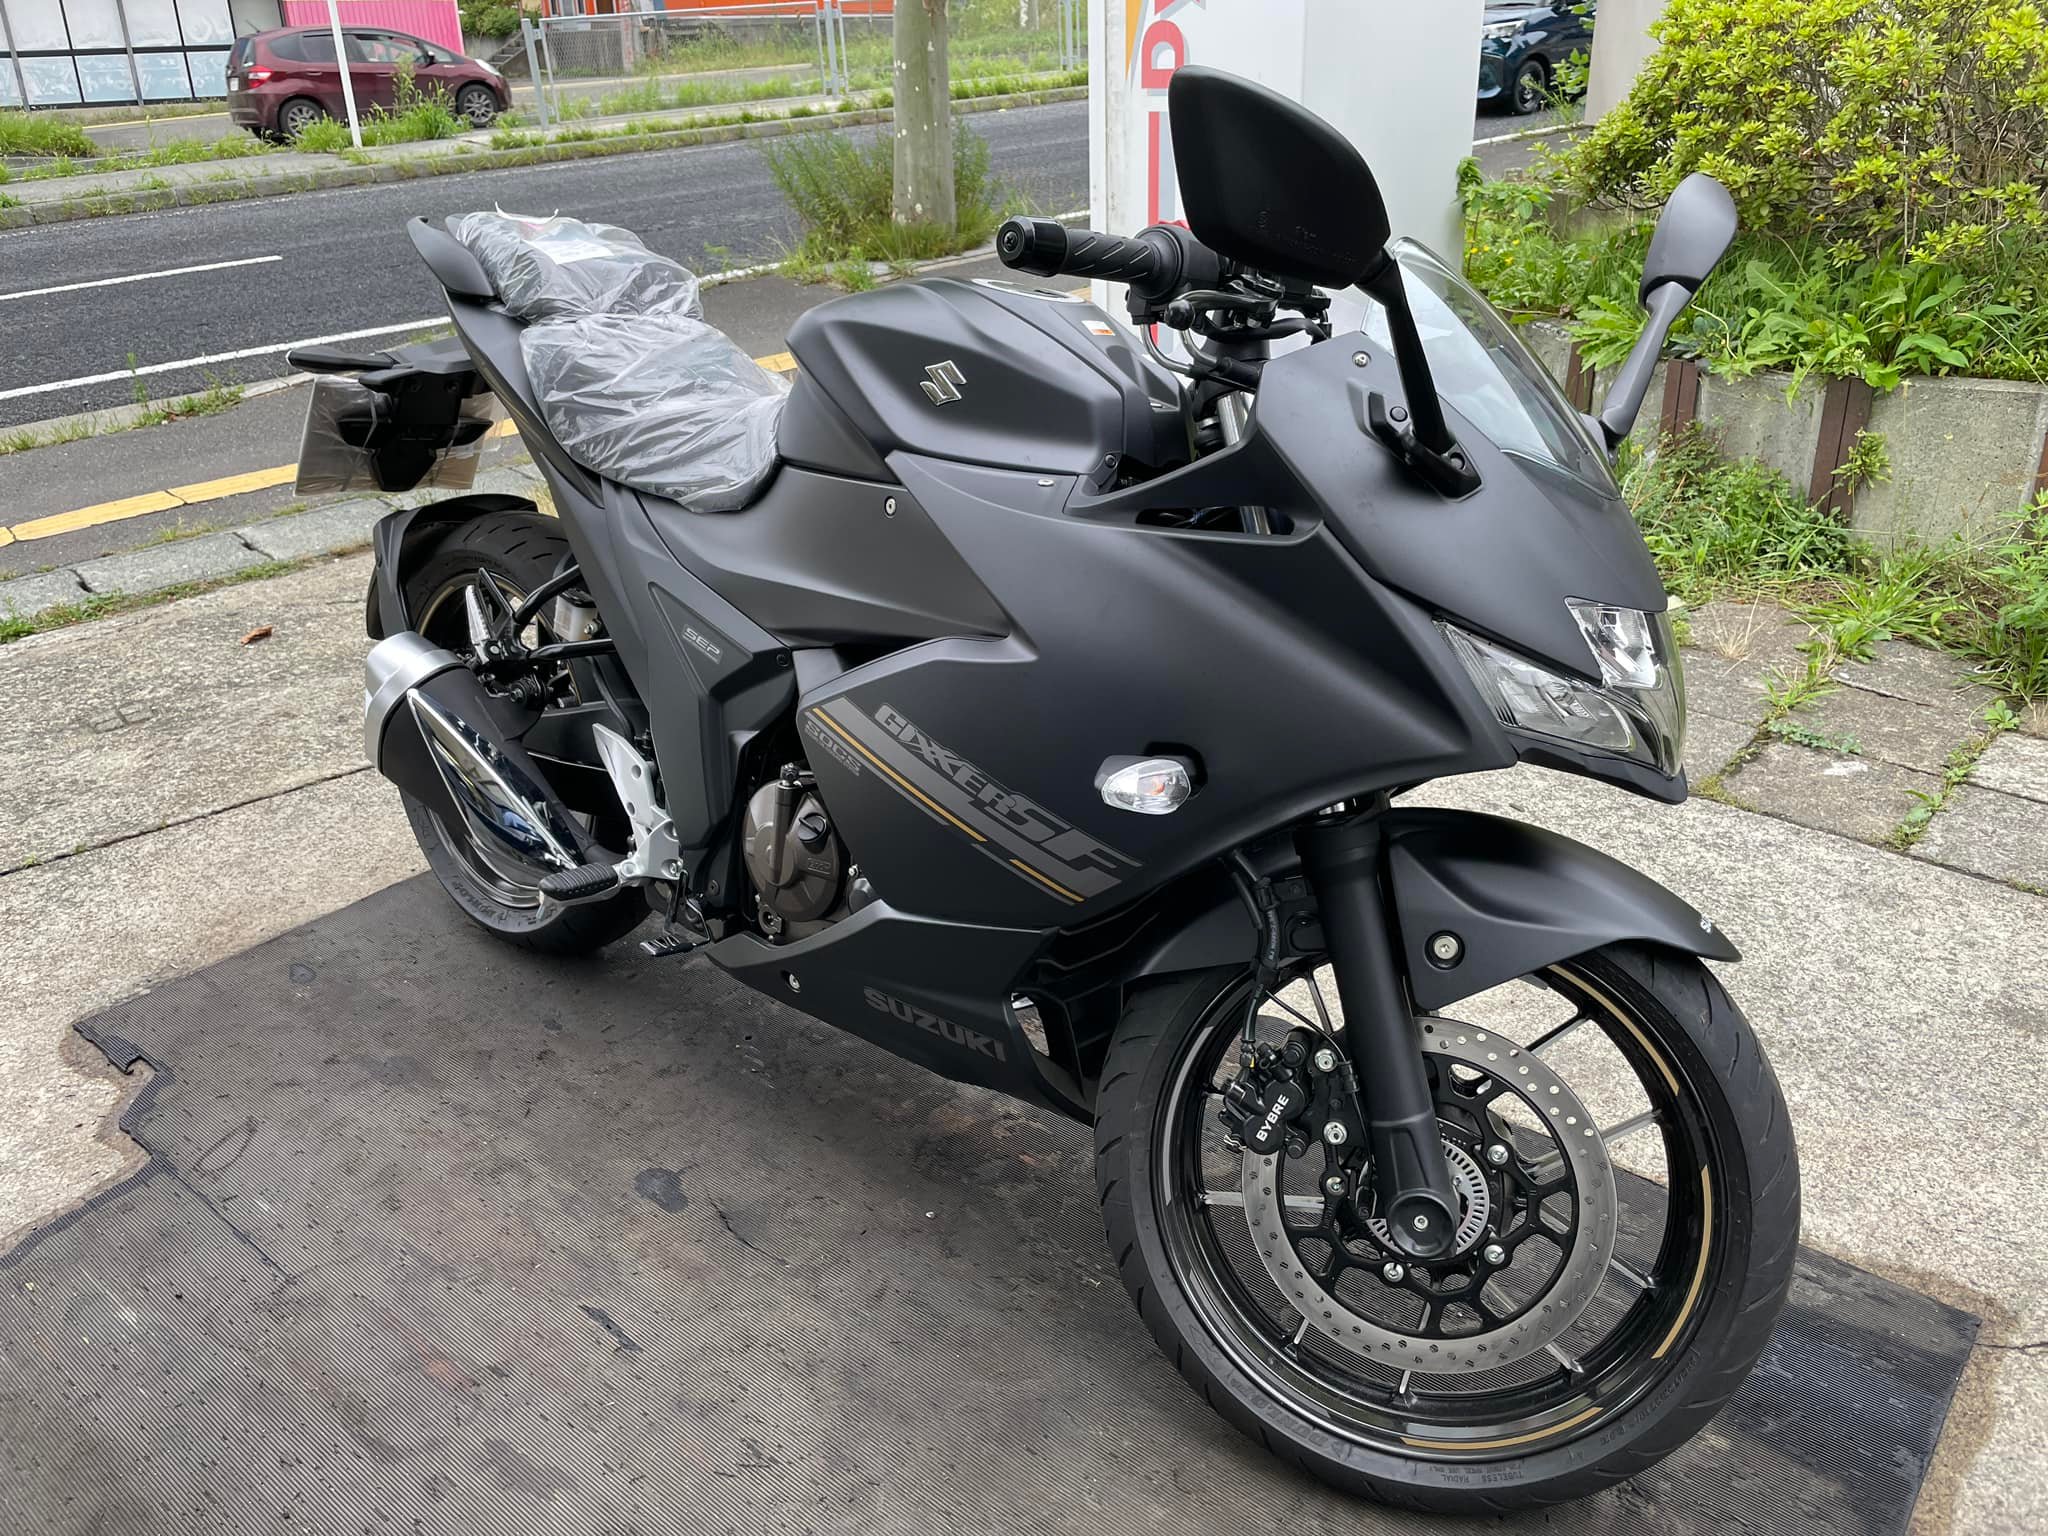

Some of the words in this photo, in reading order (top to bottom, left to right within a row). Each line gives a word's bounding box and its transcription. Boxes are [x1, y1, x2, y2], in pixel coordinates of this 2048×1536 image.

[683, 627, 720, 655] SEP
[805, 721, 861, 771] SOCS
[864, 986, 1006, 1061] SUZUKI
[1256, 1095, 1289, 1142] BYBRE
[1441, 1473, 1469, 1483] RADIAL
[1481, 1471, 1522, 1482] TUBELESS
